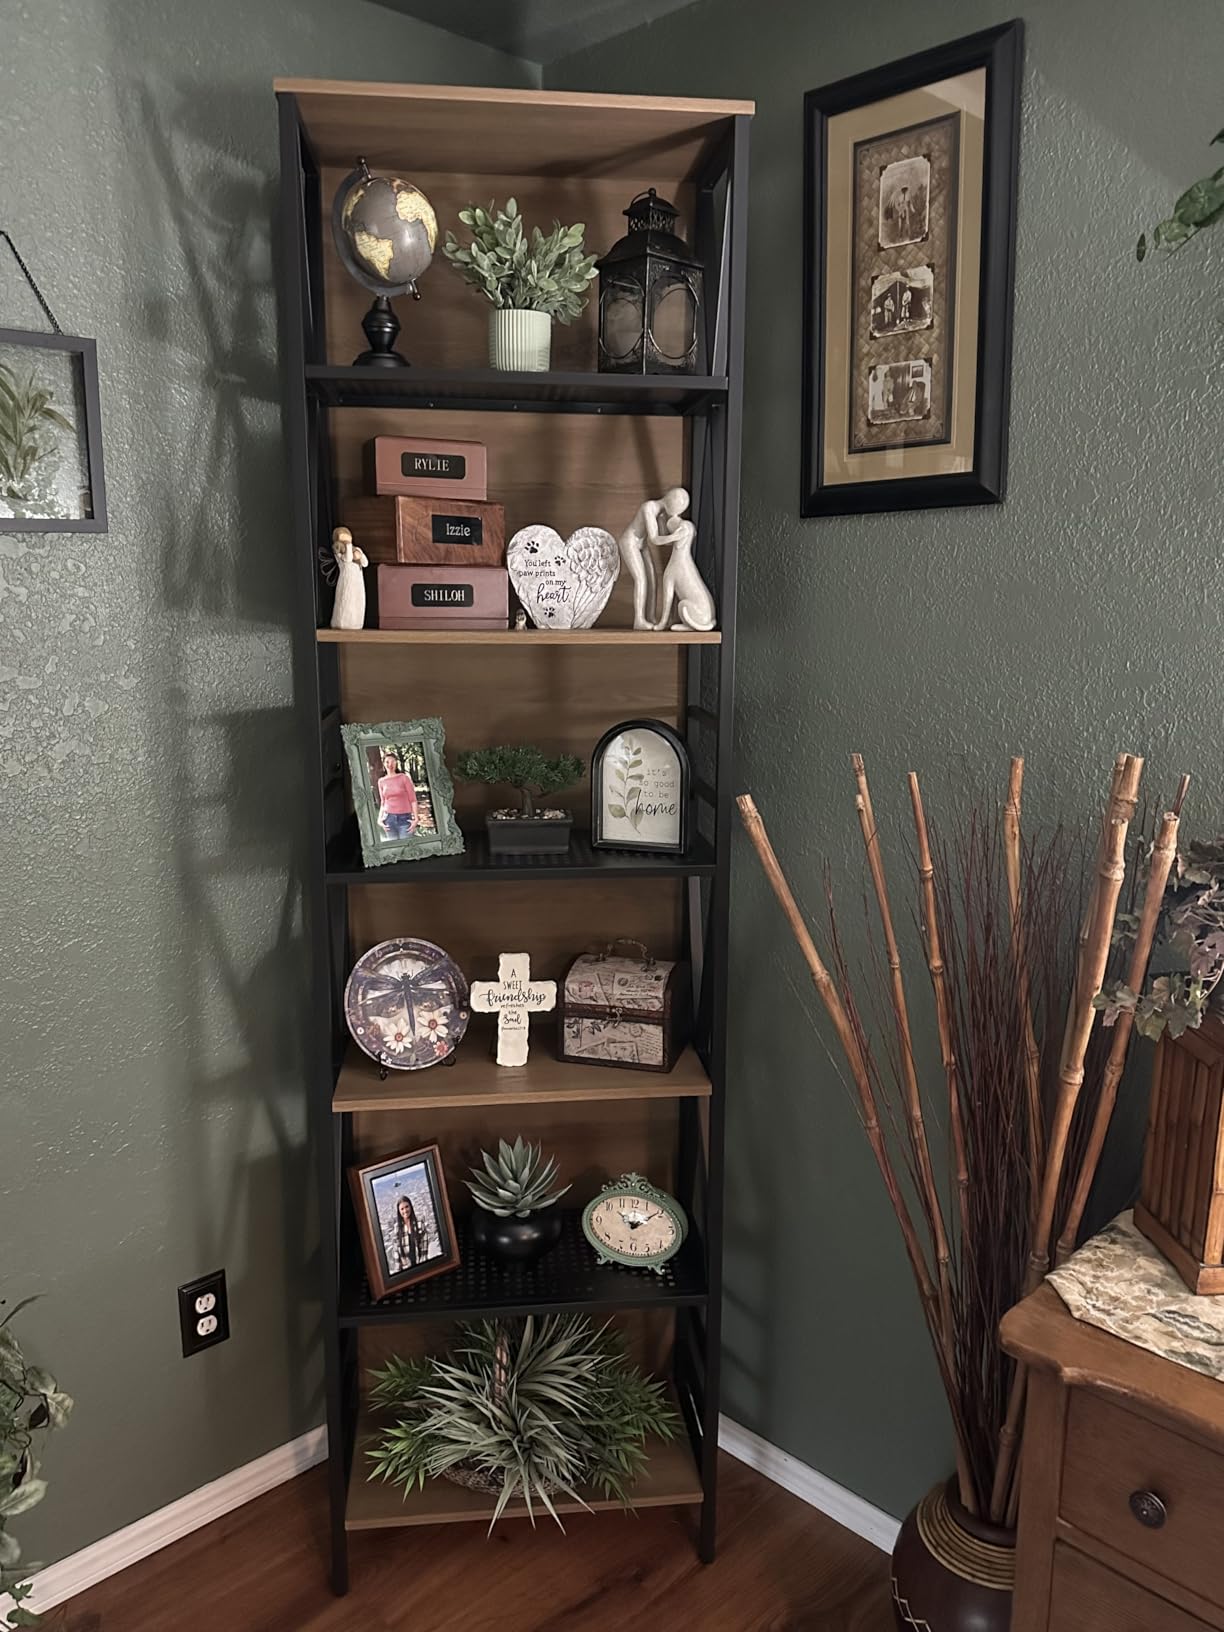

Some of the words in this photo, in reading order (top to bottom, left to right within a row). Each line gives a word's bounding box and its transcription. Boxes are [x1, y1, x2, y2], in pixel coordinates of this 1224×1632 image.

[414, 457, 450, 472] RYLIE
[446, 523, 471, 536] Izzie
[424, 589, 465, 601] SHILOH
[635, 789, 678, 816] home
[511, 968, 517, 978] A
[503, 980, 522, 990] SWEET
[479, 988, 546, 1006] friendship
[606, 1201, 613, 1211] 10
[631, 1199, 640, 1209] 12
[595, 1215, 602, 1224] 9
[629, 1242, 637, 1252] 6
